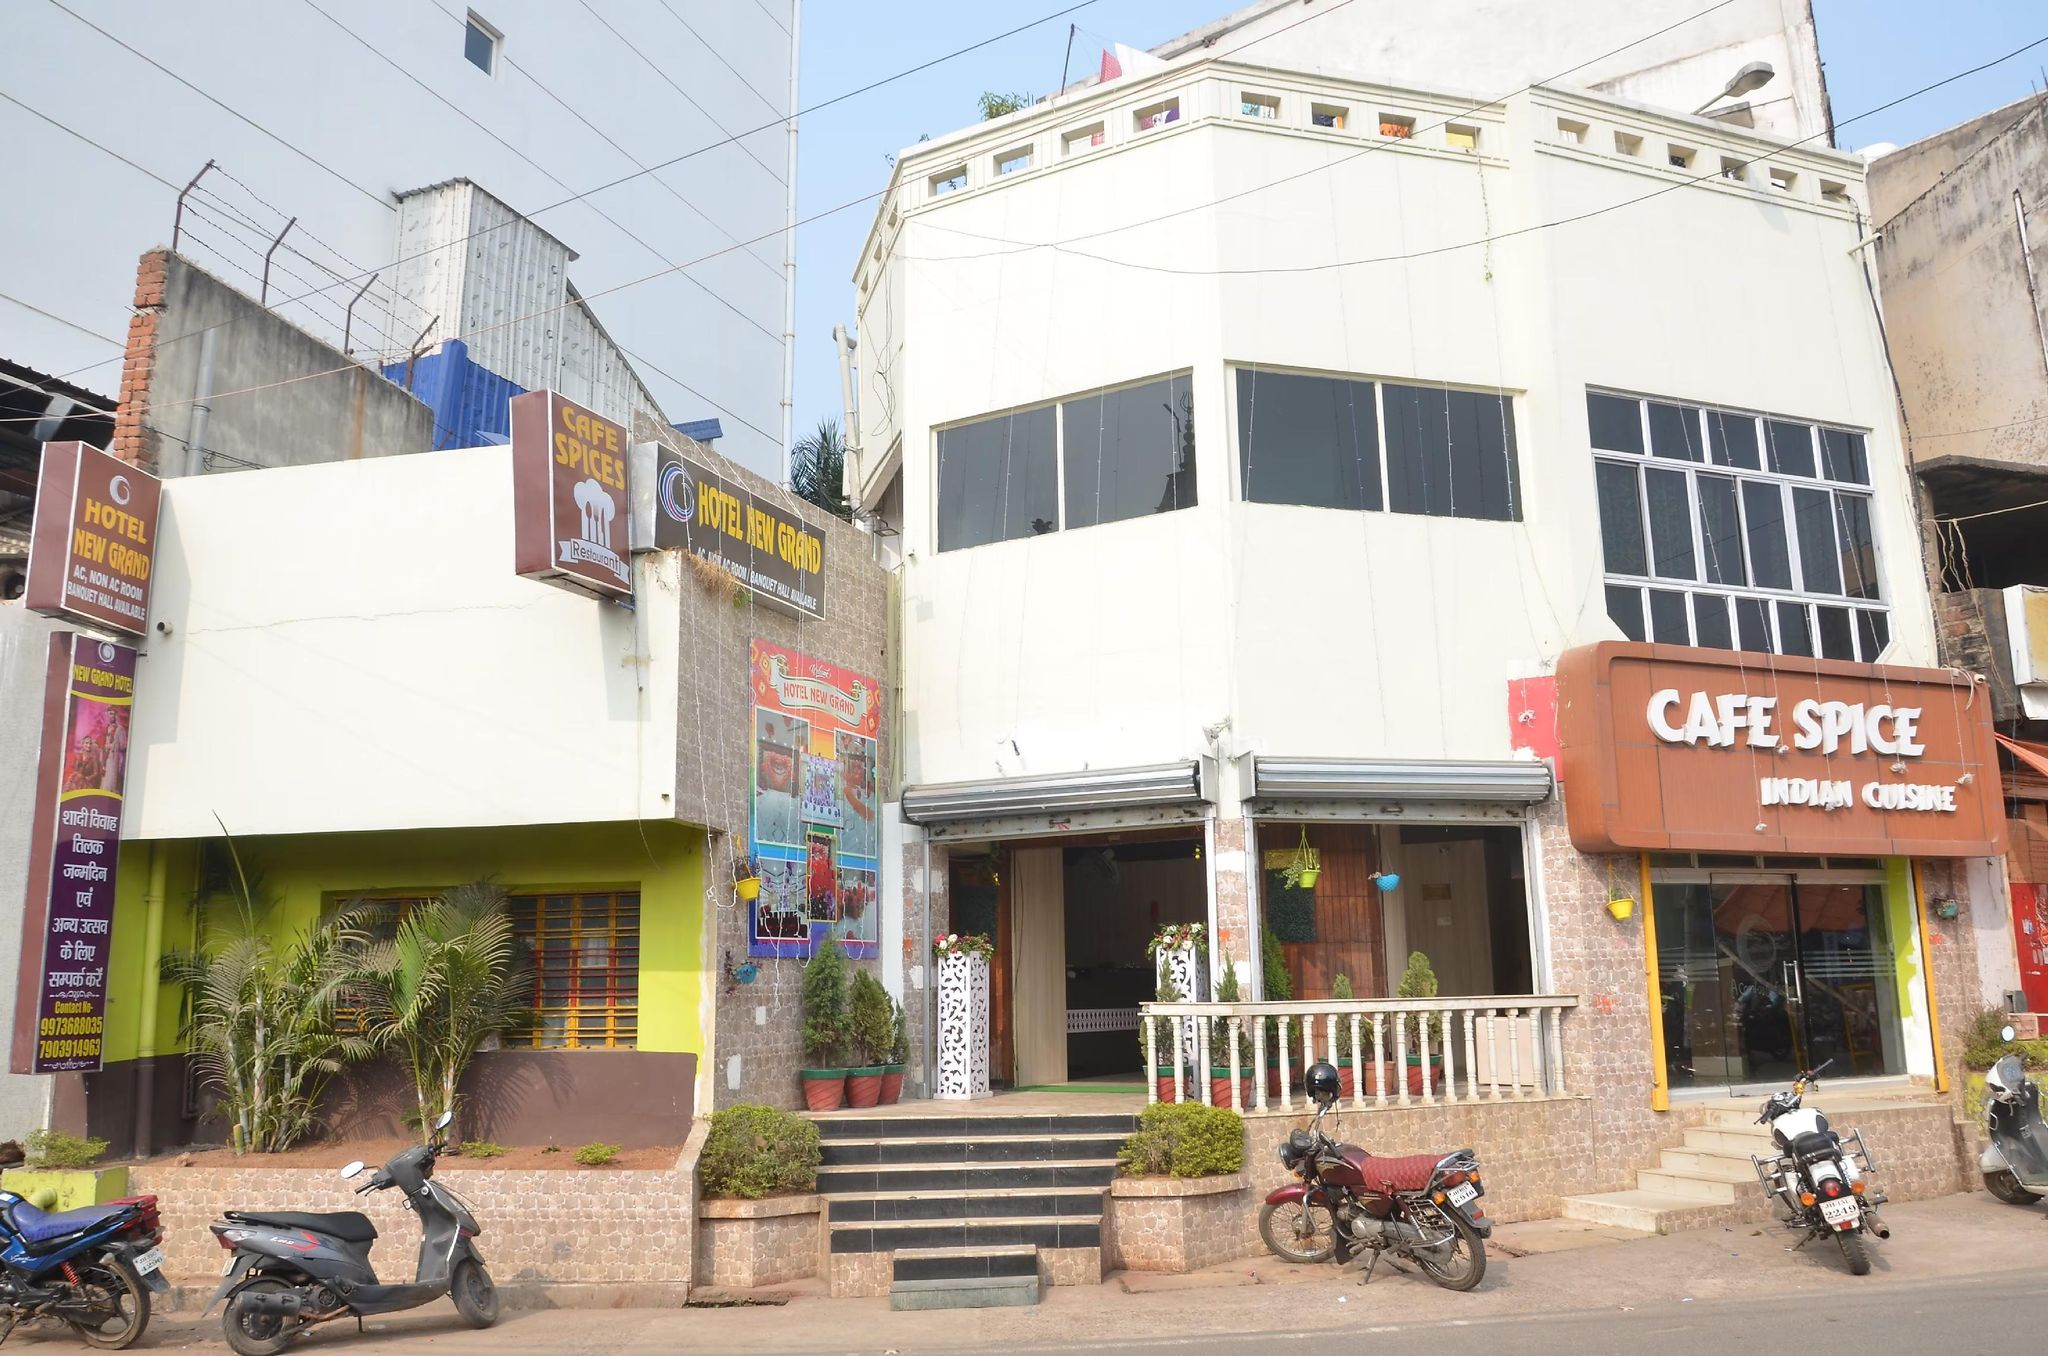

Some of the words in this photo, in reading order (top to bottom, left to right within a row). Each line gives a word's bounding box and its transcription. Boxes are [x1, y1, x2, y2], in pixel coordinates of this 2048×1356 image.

[562, 405, 619, 452] CAFE
[554, 431, 625, 491] SPICES
[84, 497, 148, 544] HOTEL
[698, 480, 743, 539] HOTEL
[746, 504, 775, 555] NEW
[778, 521, 822, 576] GRAND
[73, 528, 107, 564] NEW
[109, 542, 150, 580] GRAND
[573, 540, 618, 571] Restaurant
[89, 570, 109, 589] NON
[109, 577, 120, 593] AC
[120, 581, 144, 602] ROOM
[731, 561, 747, 581] ROOM
[750, 570, 777, 593] BANQUET
[777, 582, 790, 598] HALL
[67, 581, 98, 604] BANQUET
[98, 592, 114, 610] HALL
[114, 598, 146, 621] AVAILABLE
[74, 664, 90, 683] NEW
[91, 668, 115, 688] GRAND
[115, 674, 133, 694] HOTEL
[783, 682, 808, 700] HOTEL
[810, 687, 827, 705] NEW
[829, 694, 855, 716] GRAND
[1646, 688, 1780, 748] CAFE
[1793, 698, 1926, 758] SPICE
[1760, 776, 1854, 810] INDIAN
[1860, 781, 1958, 813] CUISINE
[62, 807, 88, 829] शादी
[89, 808, 118, 833] विवाह
[72, 833, 104, 856] तिलक
[63, 861, 107, 883] जन्मदिन
[76, 886, 93, 908] एवं
[52, 916, 79, 934] अन्य
[80, 918, 108, 935] उत्सव
[60, 941, 73, 961] के
[74, 942, 96, 961] लिए
[86, 967, 103, 987] करें
[55, 1001, 82, 1014] Contact
[41, 1016, 103, 1036] 9973688035
[39, 1038, 101, 1059] 7903914963
